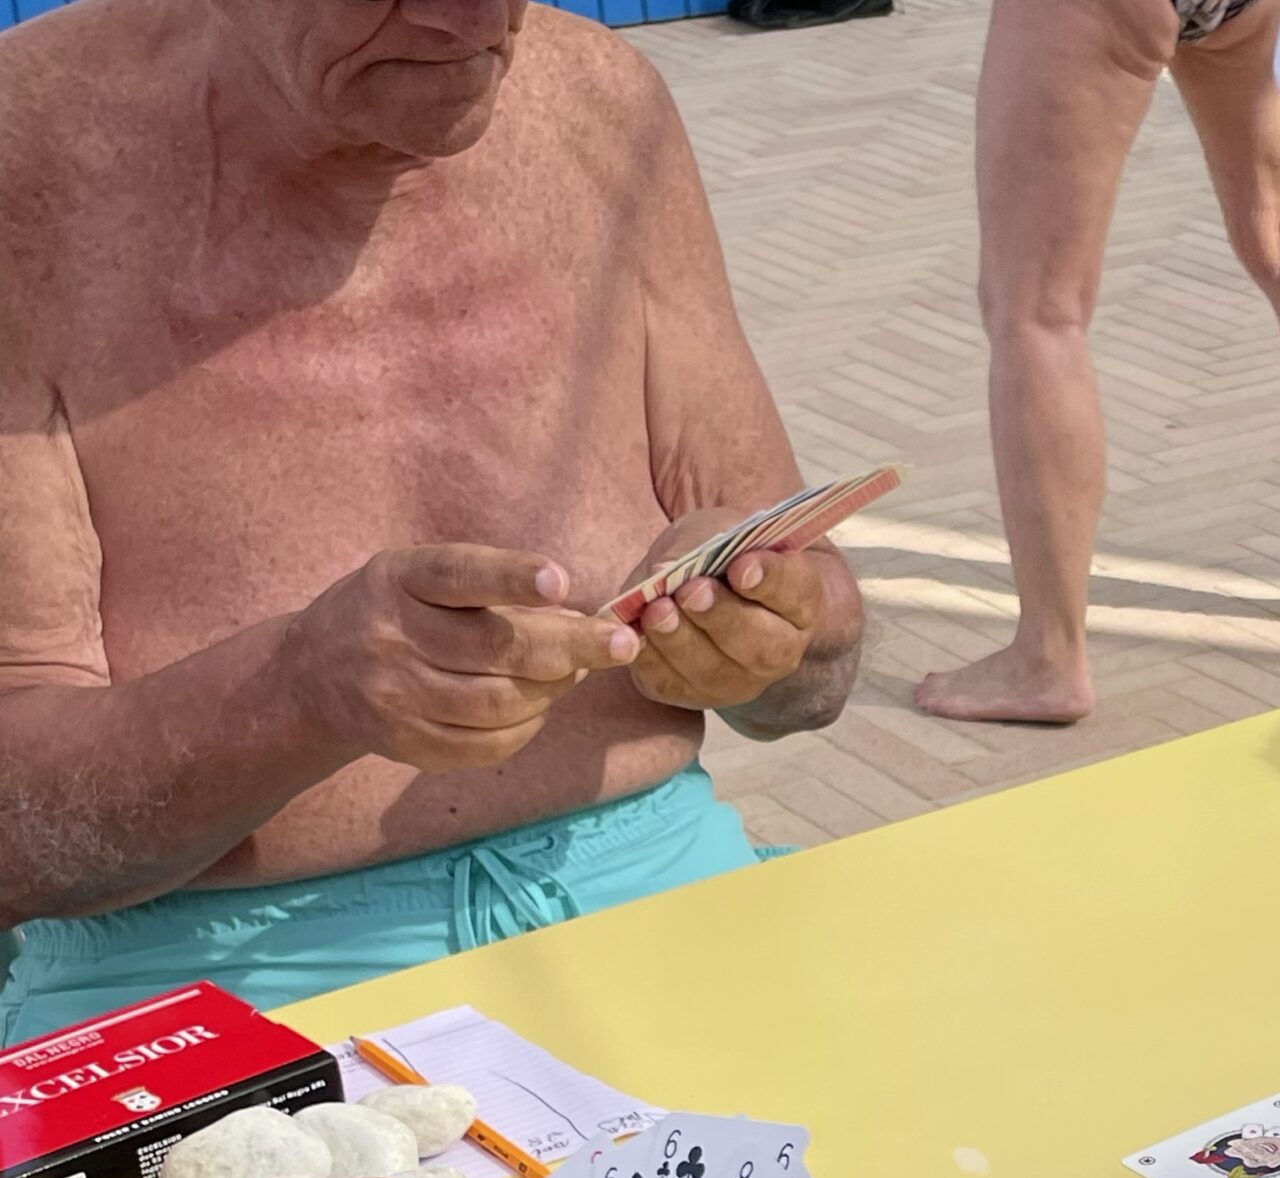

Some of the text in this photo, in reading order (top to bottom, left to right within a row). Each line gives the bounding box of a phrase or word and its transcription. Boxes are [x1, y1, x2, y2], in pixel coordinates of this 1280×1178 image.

[0, 1025, 220, 1119] XCELSIOR
[13, 1031, 103, 1068] DAL NEGRO
[94, 1126, 130, 1143] POKER
[140, 1106, 182, 1126] RAMINO
[182, 1089, 229, 1110] LEGGERO
[664, 1129, 682, 1159] 6
